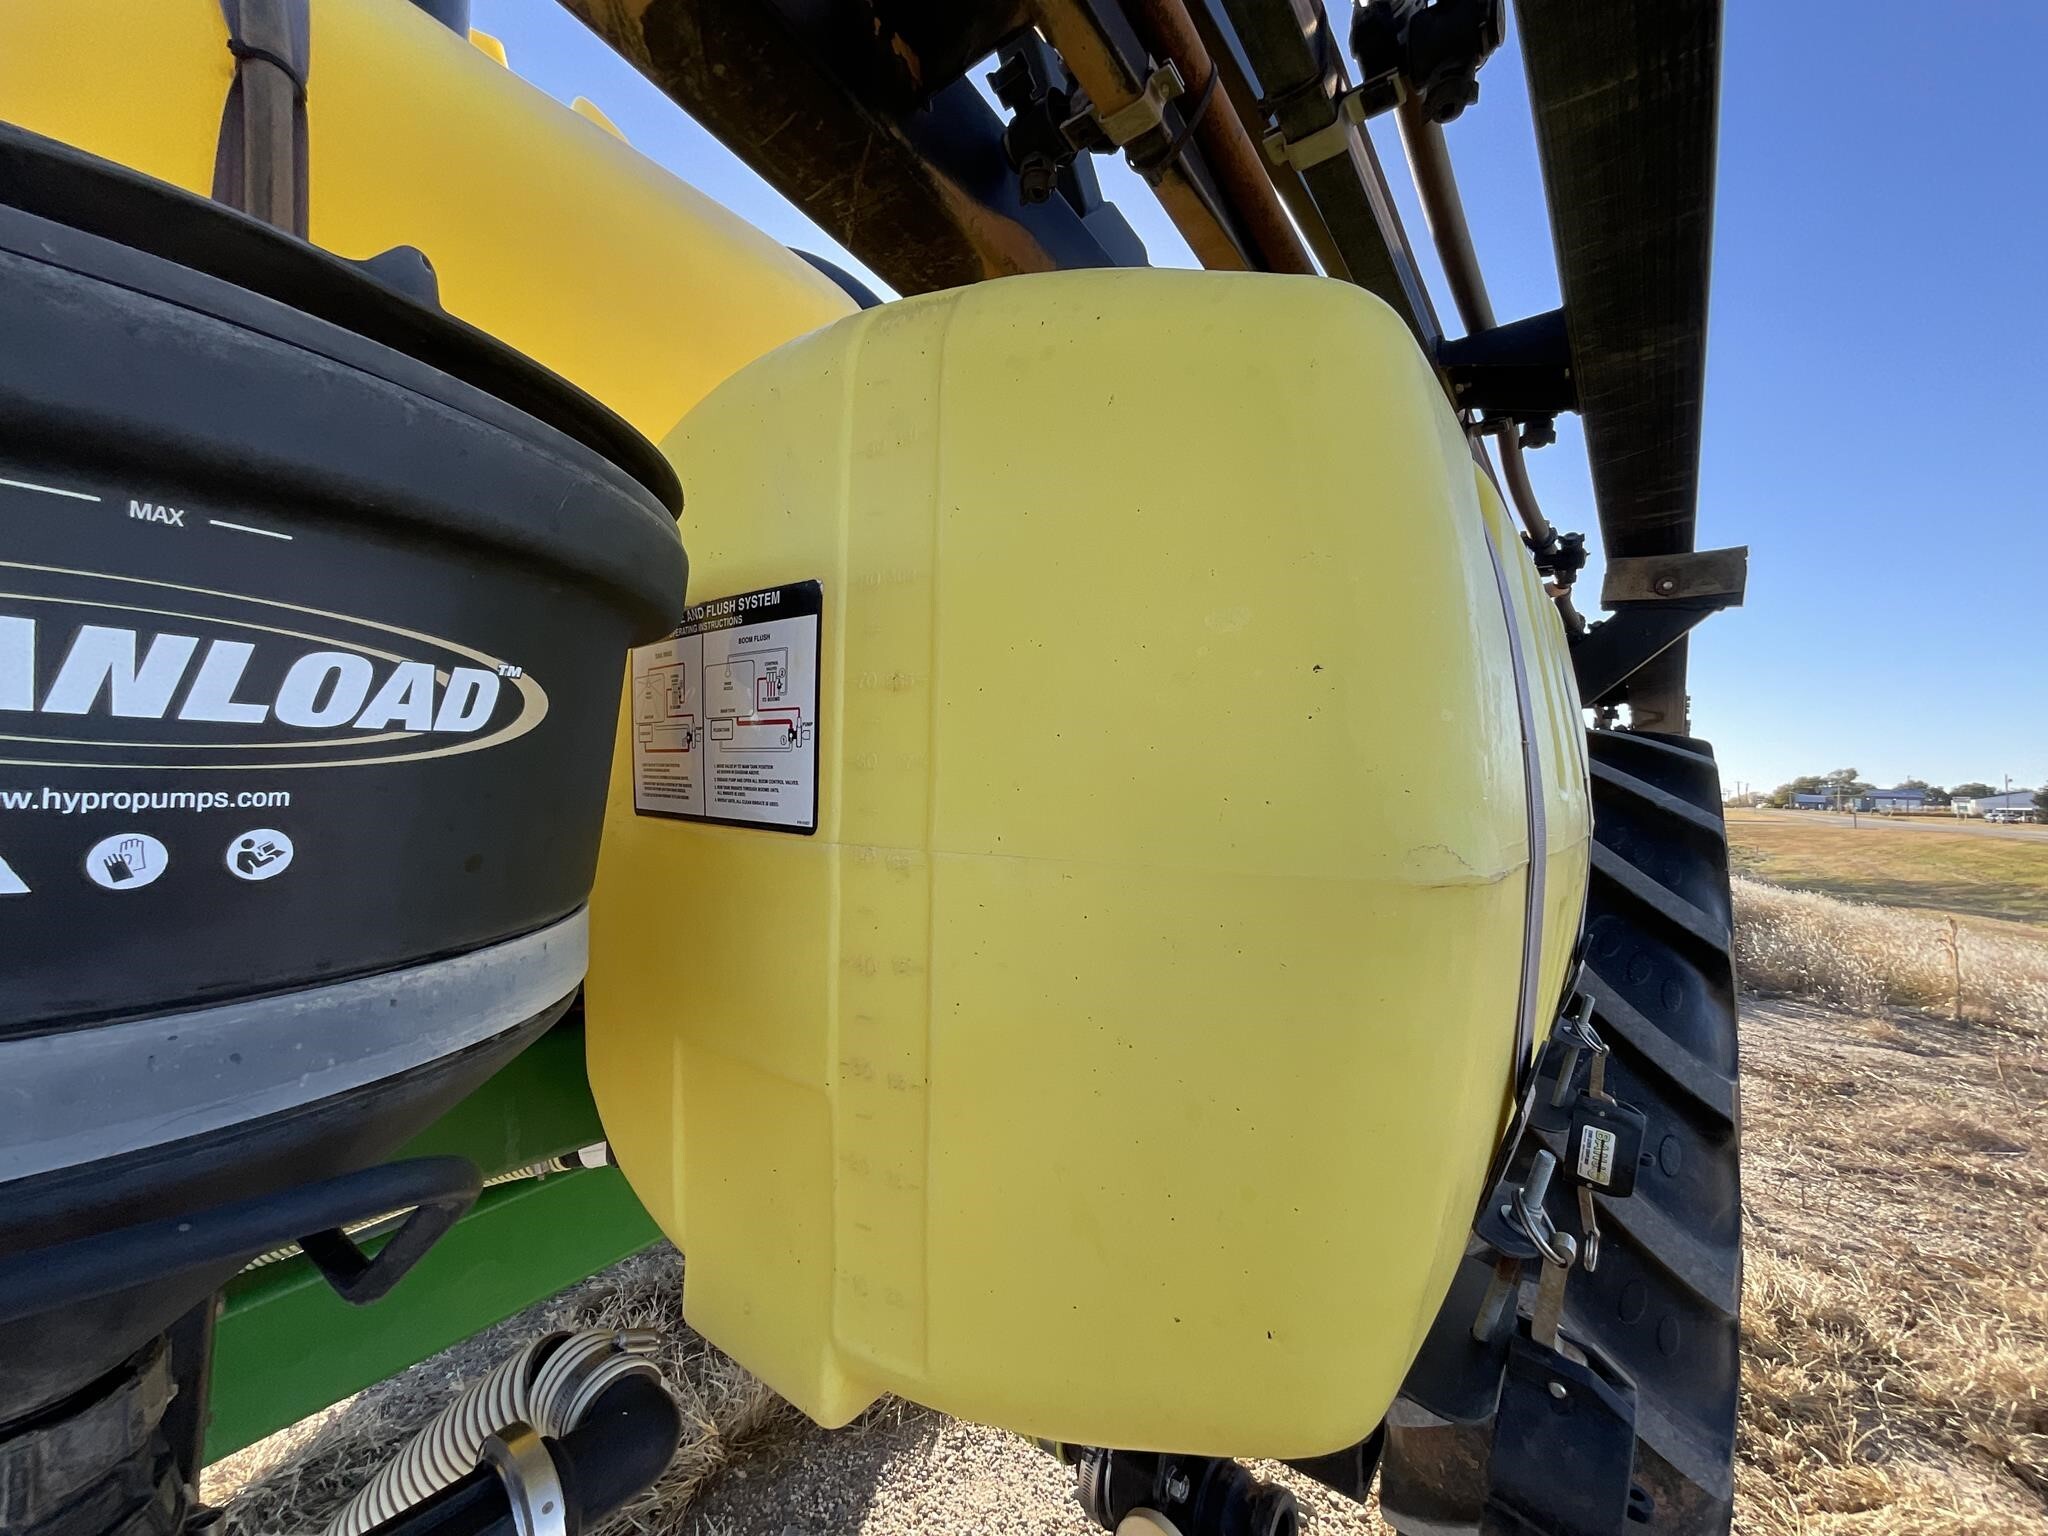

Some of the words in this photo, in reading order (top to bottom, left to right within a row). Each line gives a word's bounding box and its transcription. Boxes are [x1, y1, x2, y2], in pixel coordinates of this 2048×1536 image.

[129, 500, 185, 527] MAX
[686, 607, 705, 623] AND
[706, 599, 736, 618] FLUSH
[738, 590, 781, 611] SYSTEM
[699, 615, 743, 632] INSTRUCTIONS
[738, 635, 753, 645] BOOM
[754, 633, 771, 643] FLUSH
[0, 787, 291, 814] w.hypropumps.com
